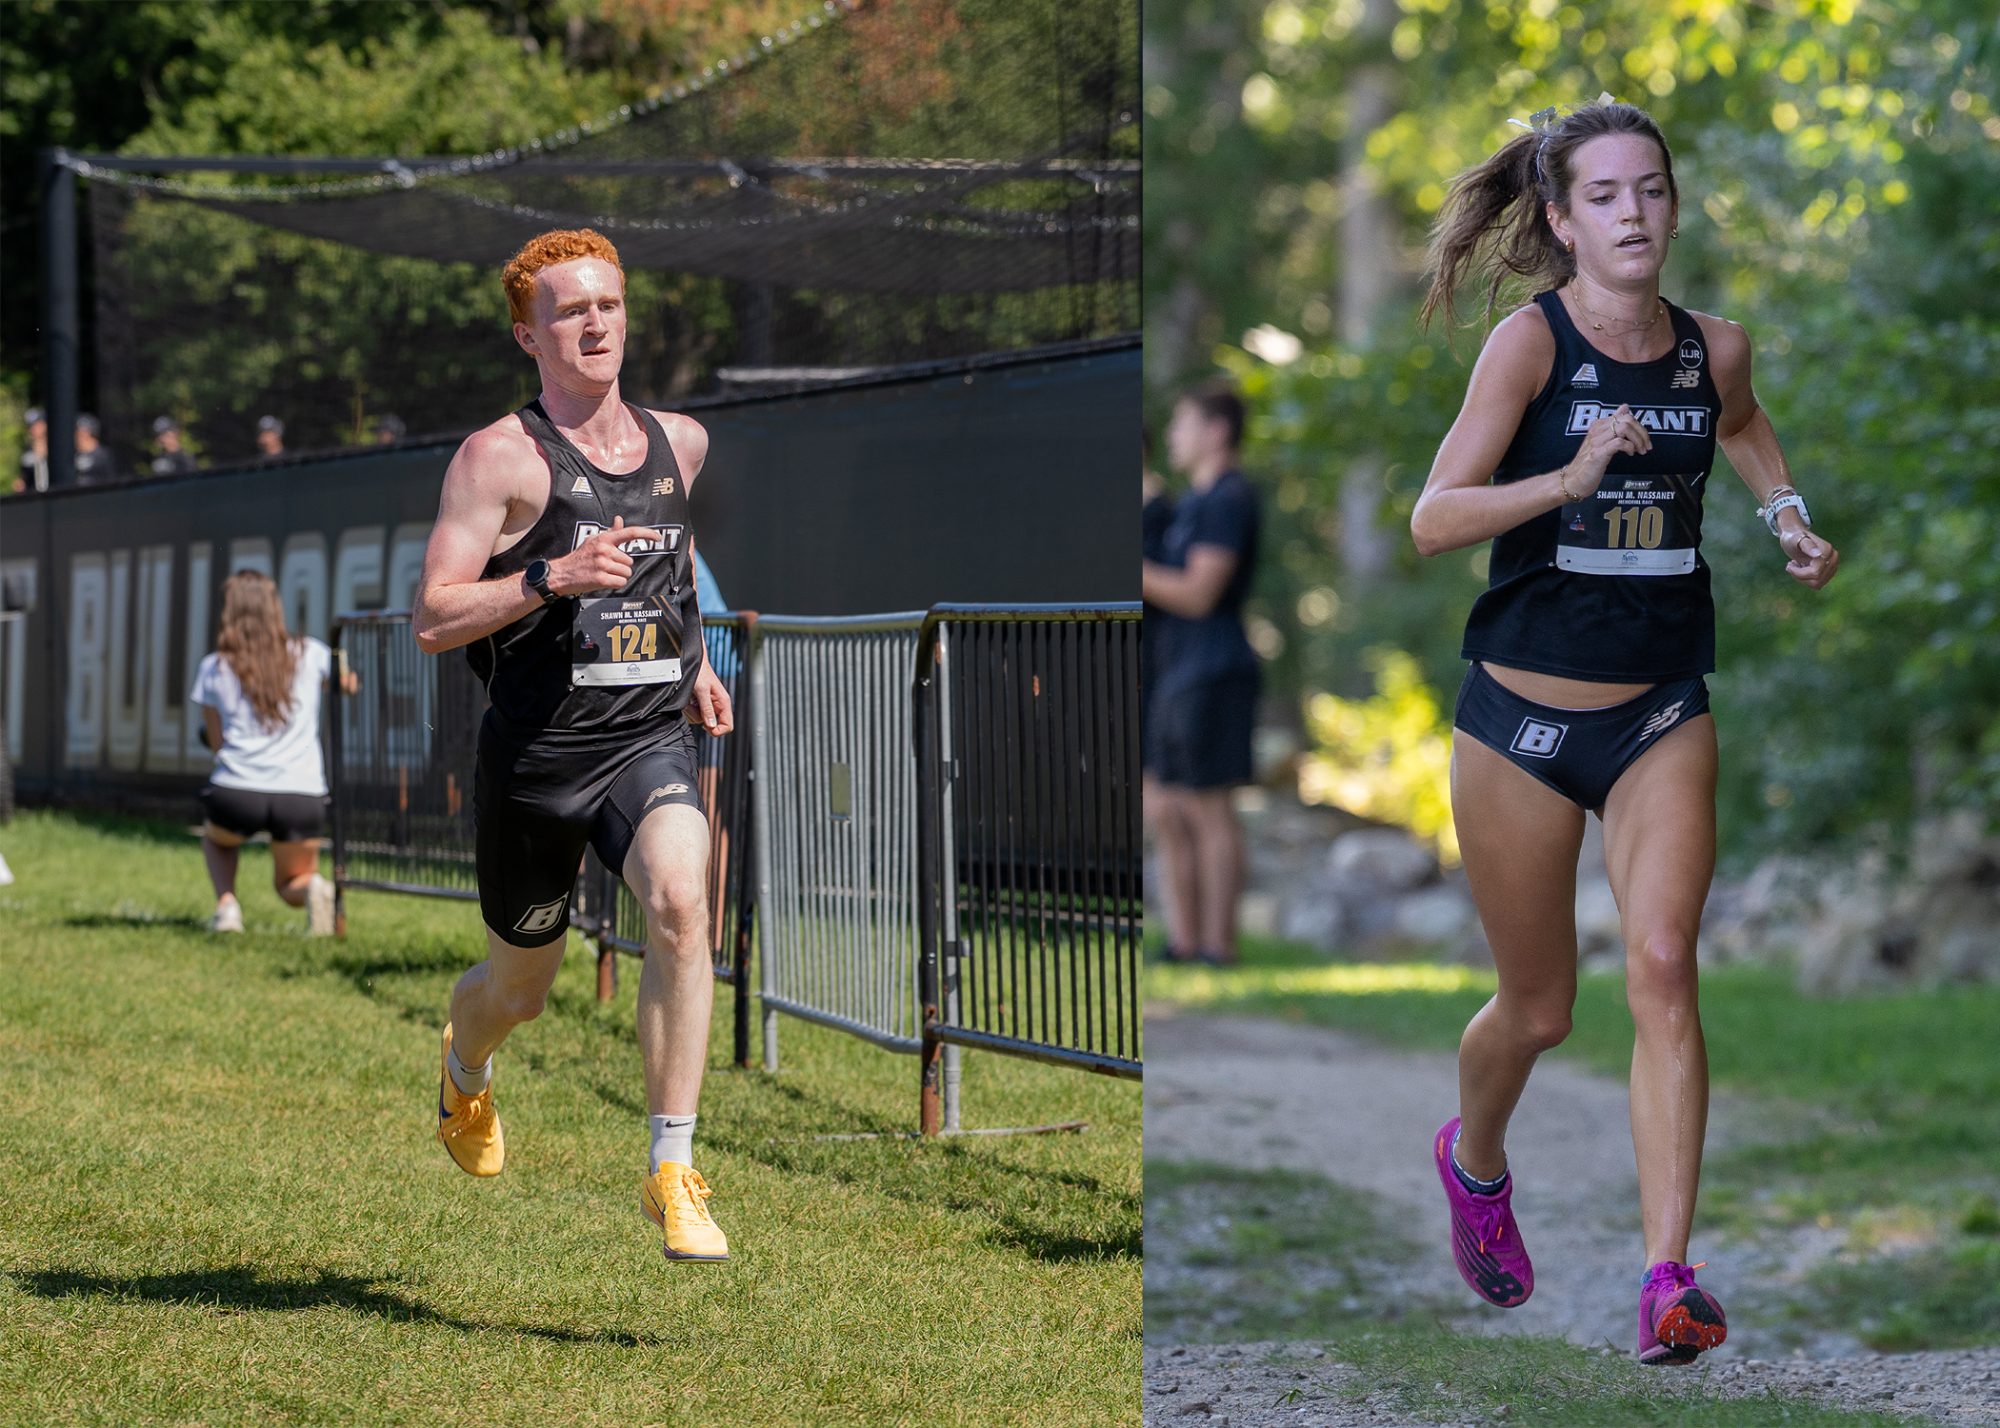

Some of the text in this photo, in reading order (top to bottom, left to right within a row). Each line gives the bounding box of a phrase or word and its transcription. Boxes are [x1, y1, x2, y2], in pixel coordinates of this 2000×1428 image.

[1597, 490, 1676, 500] SHAWN M. NASSANEY
[576, 524, 681, 552] BANT
[1603, 506, 1664, 549] 110
[600, 609, 663, 620] SHAWN M. NASSANEY
[606, 623, 658, 662] 124
[1517, 722, 1560, 754] B
[521, 900, 563, 931] B
